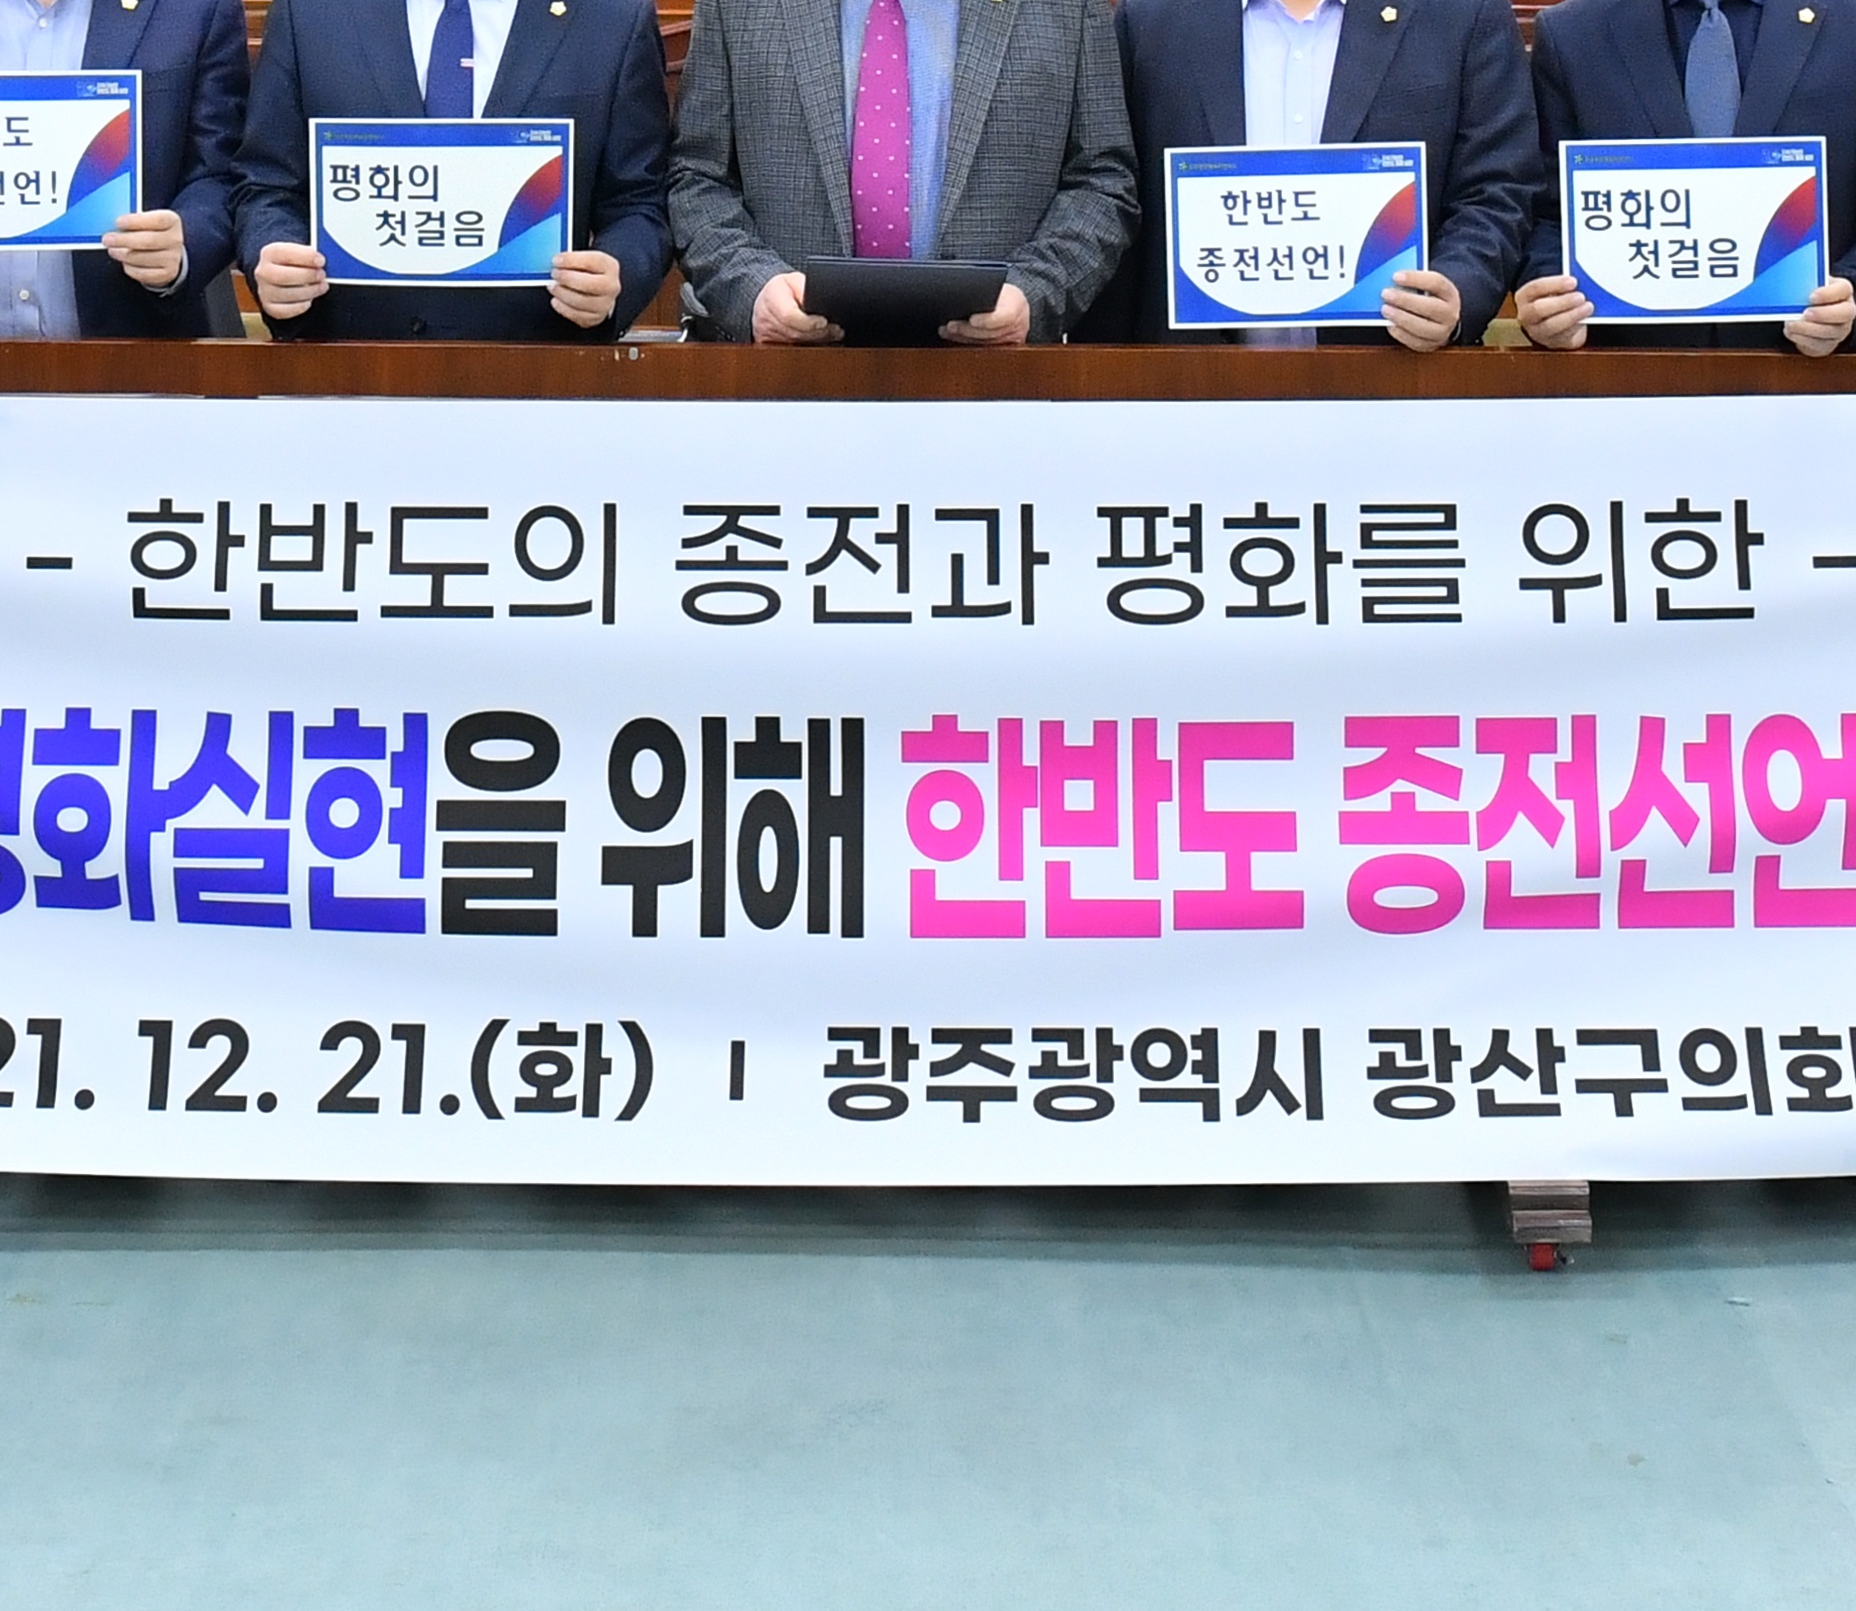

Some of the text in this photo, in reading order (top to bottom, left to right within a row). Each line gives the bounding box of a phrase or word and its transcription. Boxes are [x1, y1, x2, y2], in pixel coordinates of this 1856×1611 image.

[330, 165, 438, 202] 평화의
[376, 210, 484, 246] 첫걸음
[1221, 190, 1320, 225] 한반도
[1581, 189, 1690, 231] 평화의
[1197, 245, 1346, 282] 종전선언!
[1629, 238, 1739, 279] 첫걸음
[128, 499, 616, 624] 한반도의
[676, 504, 1049, 625] 종전과
[1097, 502, 1465, 625] 평화를
[1519, 498, 1764, 623] 위한
[601, 717, 864, 938] 위해
[902, 715, 1304, 938] 한반도
[138, 1019, 277, 1113] 12.
[318, 1019, 653, 1121] 21.(화)
[824, 1027, 1323, 1123] 광주광역시
